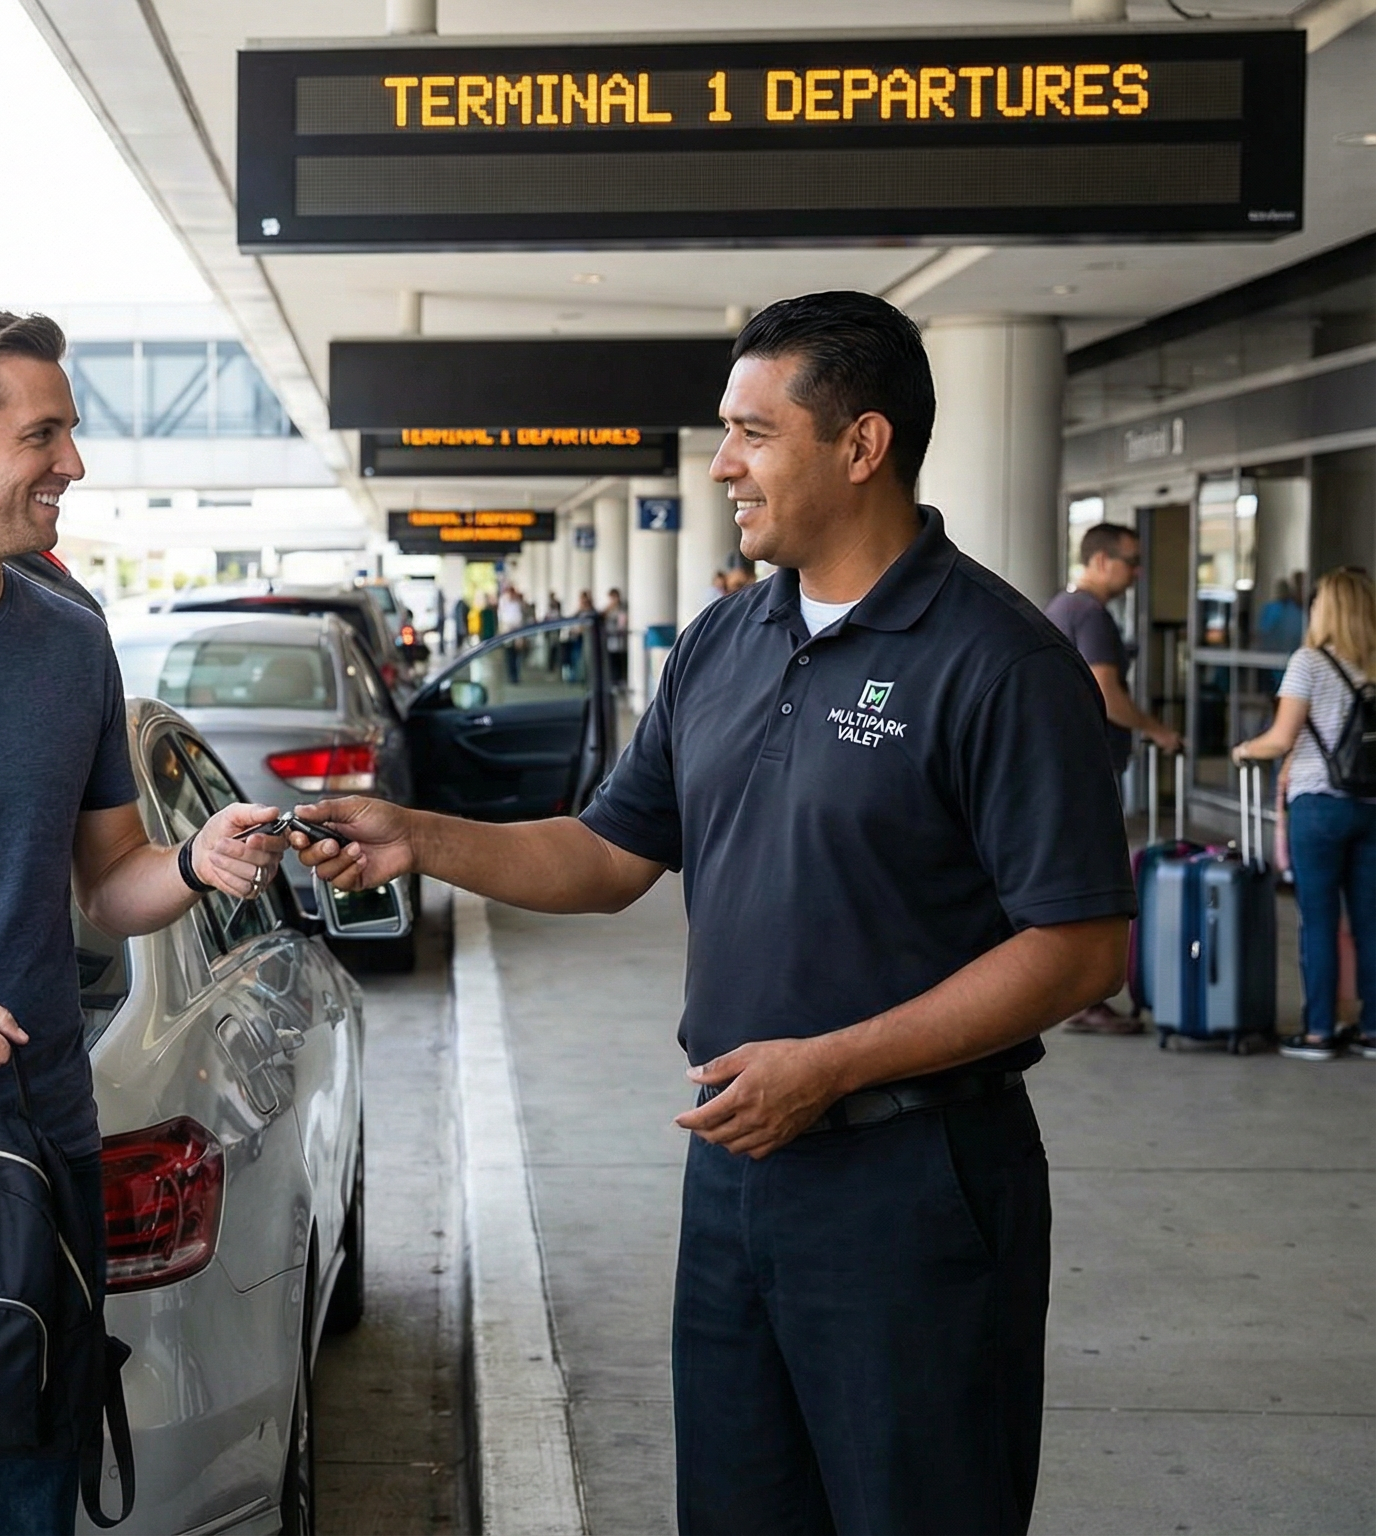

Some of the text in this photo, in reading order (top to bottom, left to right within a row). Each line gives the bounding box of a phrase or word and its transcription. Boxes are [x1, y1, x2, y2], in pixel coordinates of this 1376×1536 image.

[384, 63, 1148, 127] TERMINAL 1 DEPARTURES
[649, 505, 668, 529] 2
[826, 707, 908, 738] MULTIPARK
[837, 725, 884, 748] VALET
